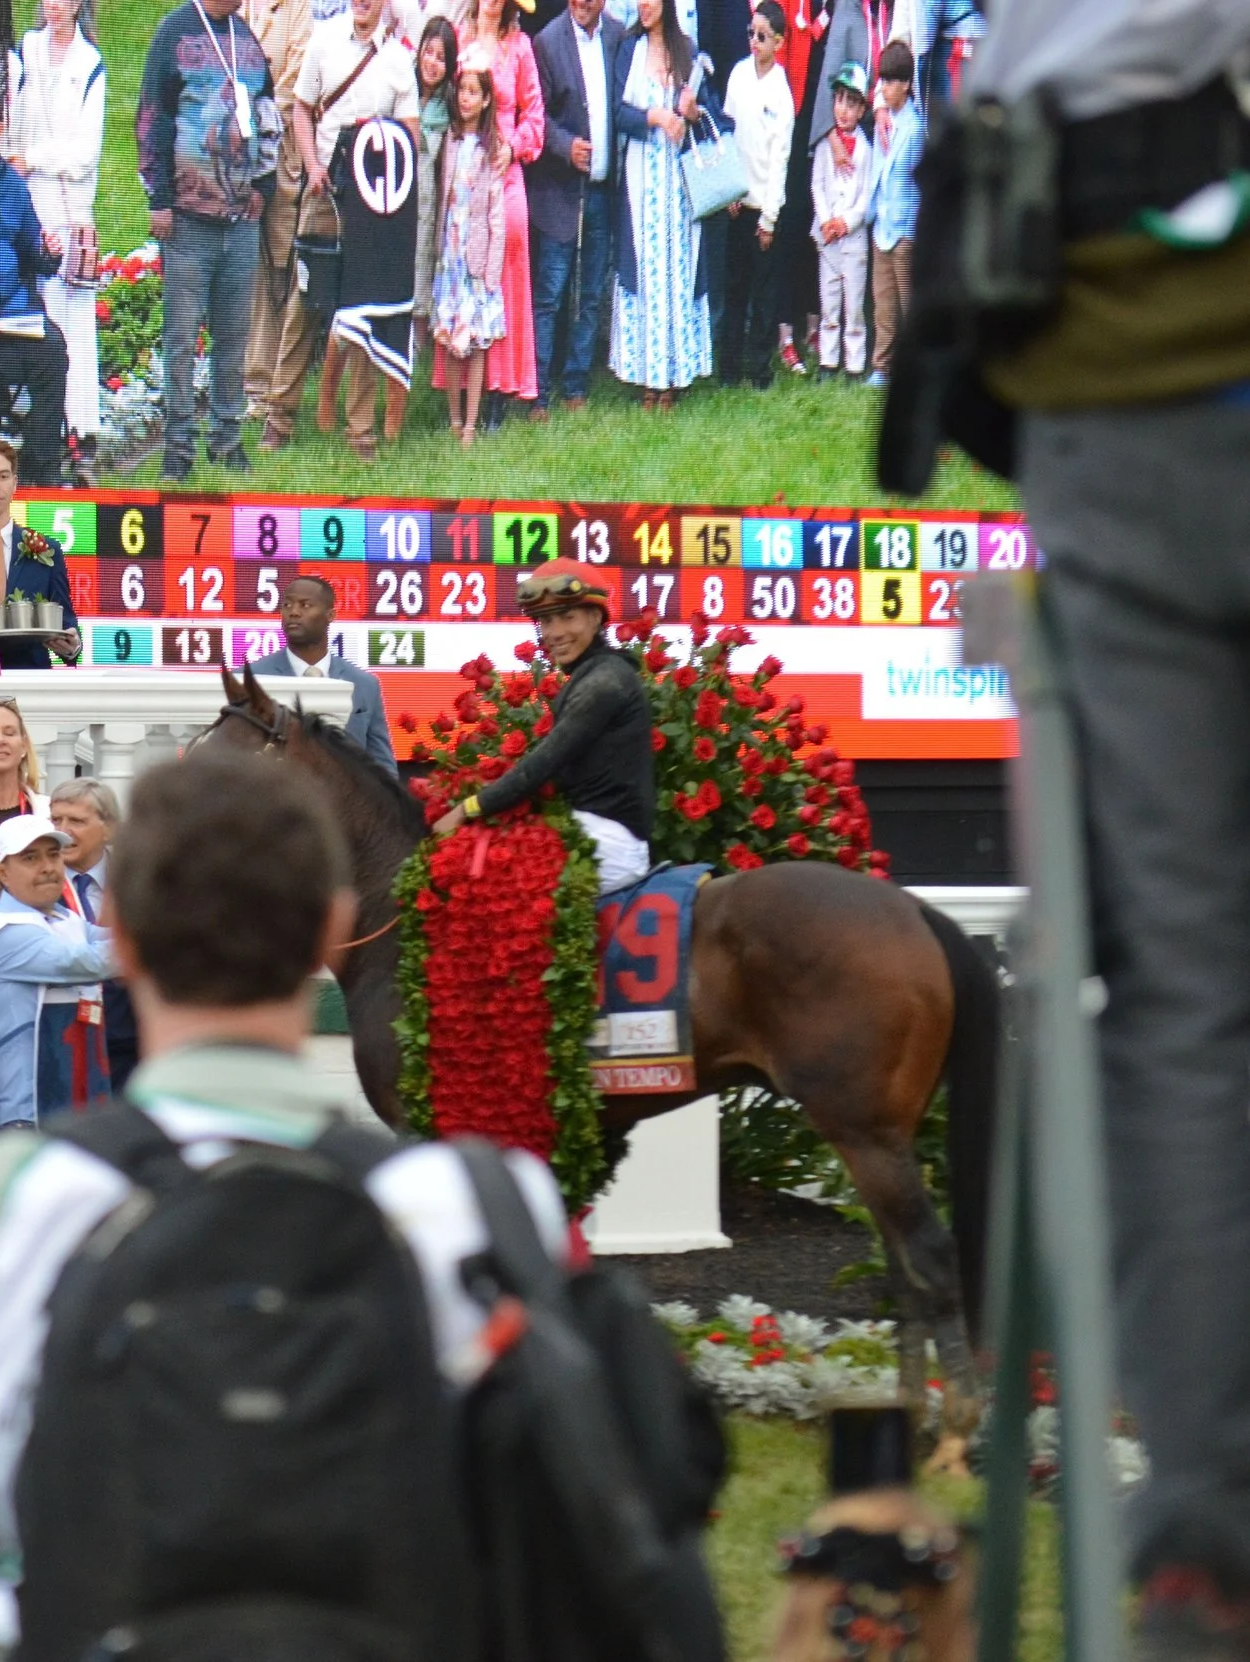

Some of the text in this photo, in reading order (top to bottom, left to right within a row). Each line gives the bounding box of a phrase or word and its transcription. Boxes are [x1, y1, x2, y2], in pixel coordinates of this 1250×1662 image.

[52, 508, 1027, 570] 5 6 7 8 9 10 11 12 13 14 15 16 17 18 19 20
[121, 564, 145, 610] 6
[178, 566, 224, 612] 12
[256, 568, 279, 612] 5
[375, 569, 423, 616] 26
[440, 571, 487, 616] 23
[631, 573, 674, 618] 17
[702, 575, 724, 618] 8
[751, 575, 796, 619] 50
[812, 577, 856, 620] 38
[882, 578, 903, 620] 5
[114, 628, 131, 661] 9
[175, 628, 211, 663] 13
[244, 630, 281, 663] 20
[378, 632, 416, 665] 24
[618, 1065, 682, 1088] TEMPO
